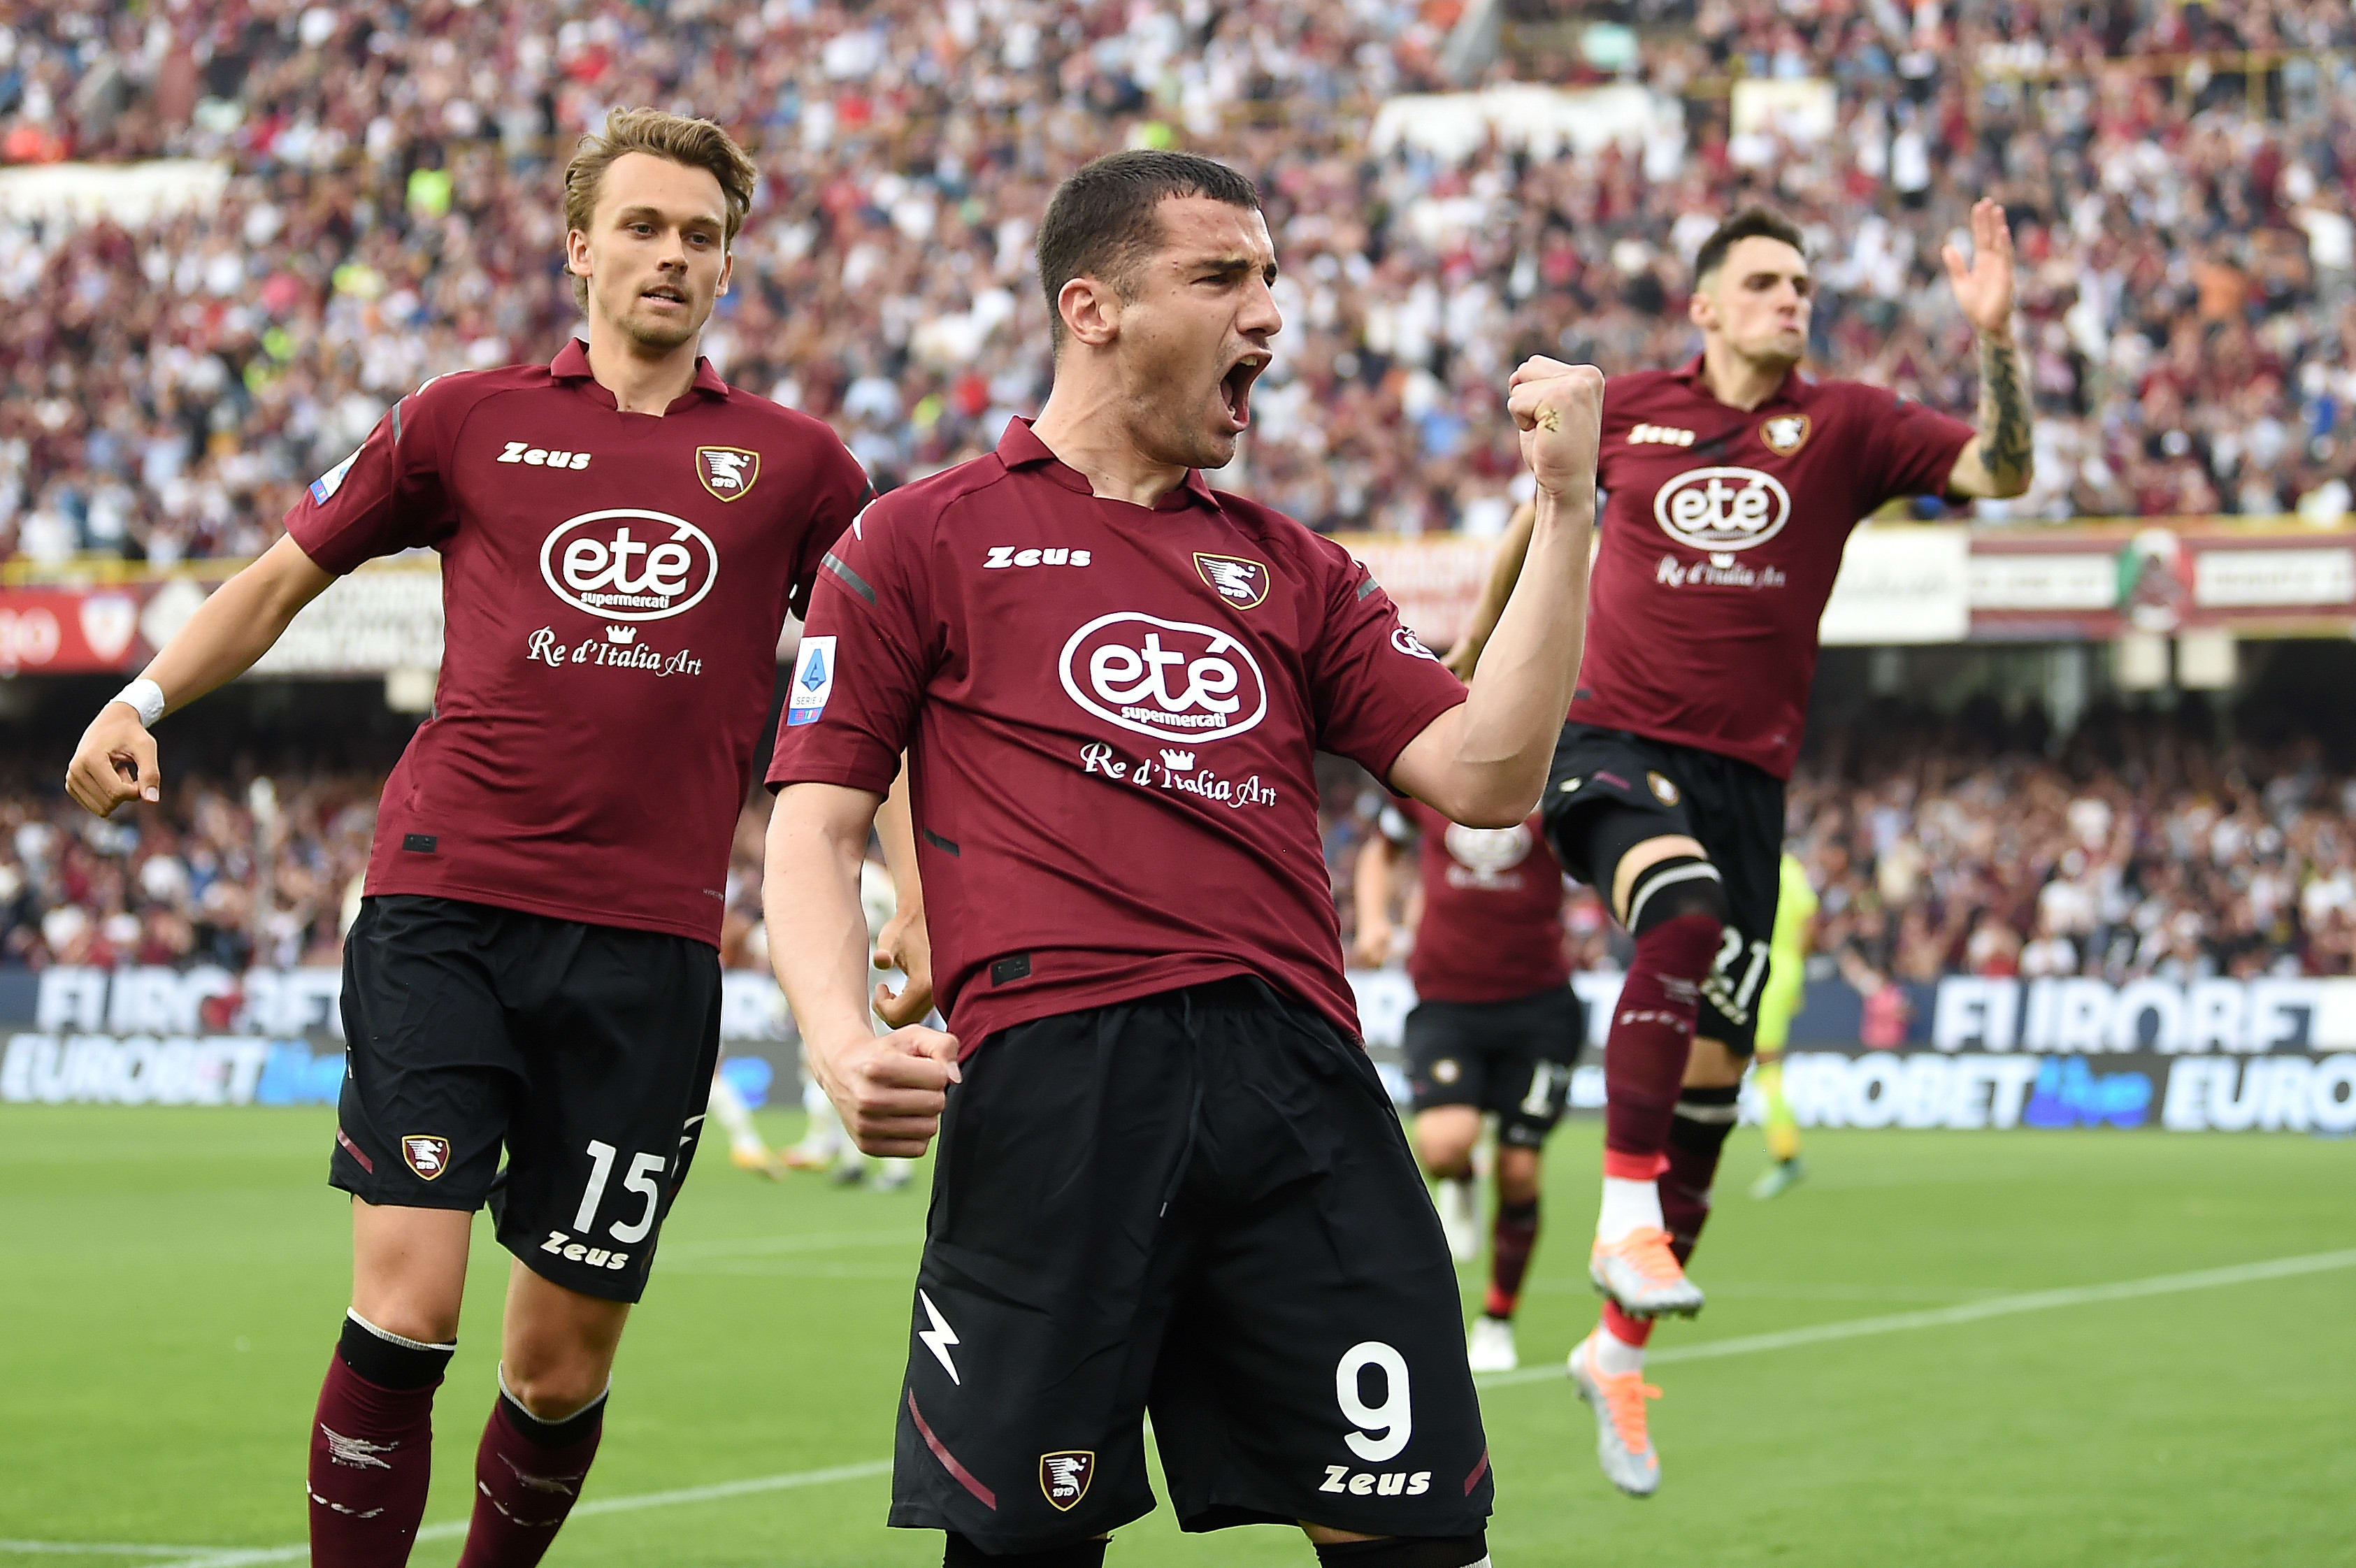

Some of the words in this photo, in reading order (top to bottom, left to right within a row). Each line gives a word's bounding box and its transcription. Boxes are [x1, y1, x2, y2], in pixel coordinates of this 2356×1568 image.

[496, 441, 591, 470] Zeus
[711, 477, 737, 488] 1919
[1671, 477, 1769, 531] eté
[562, 526, 693, 596] eté
[982, 546, 1091, 568] Zeus
[580, 592, 669, 608] supermercati
[1217, 586, 1247, 598] 1919
[526, 626, 566, 668] Re
[571, 638, 661, 670] d'Italia
[656, 649, 702, 677] Art
[1090, 632, 1240, 714] eté
[1121, 706, 1227, 728] supermercati
[1080, 741, 1127, 779] Re
[1132, 758, 1232, 800] d'Italia
[1227, 775, 1277, 808] Art
[1709, 924, 1769, 1008] 21
[36, 966, 341, 1036] EUROBE
[573, 1139, 665, 1244] 15
[540, 1230, 629, 1269] Zeus
[1336, 1341, 1412, 1462] 9
[1052, 1487, 1075, 1497] 1919
[1319, 1465, 1432, 1495] Zeus
